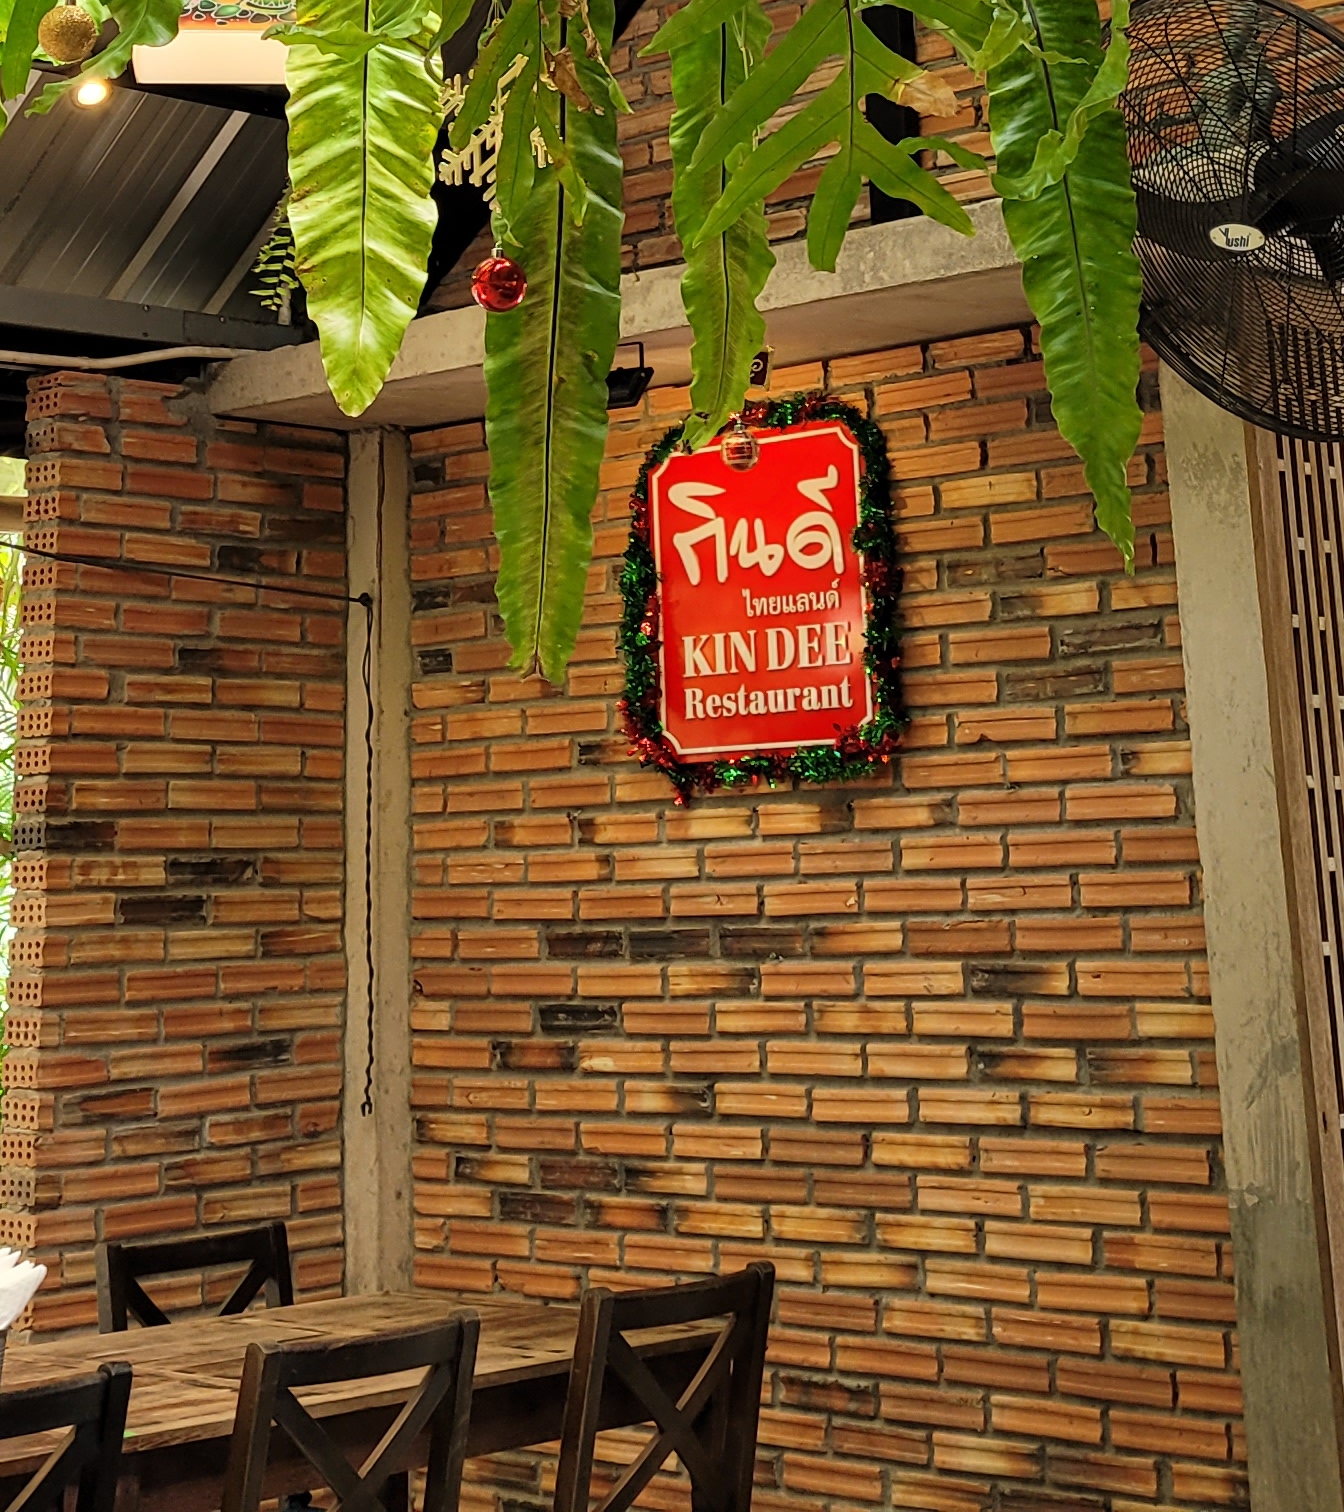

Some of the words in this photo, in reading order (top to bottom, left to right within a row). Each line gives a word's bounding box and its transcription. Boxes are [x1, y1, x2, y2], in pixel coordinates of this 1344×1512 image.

[1218, 227, 1252, 248] Yushi
[667, 464, 845, 586] กินดี
[741, 578, 841, 617] ไทยแลนด์
[681, 630, 757, 678] KIN
[765, 621, 852, 671] DEE
[683, 675, 854, 720] Restaurant
